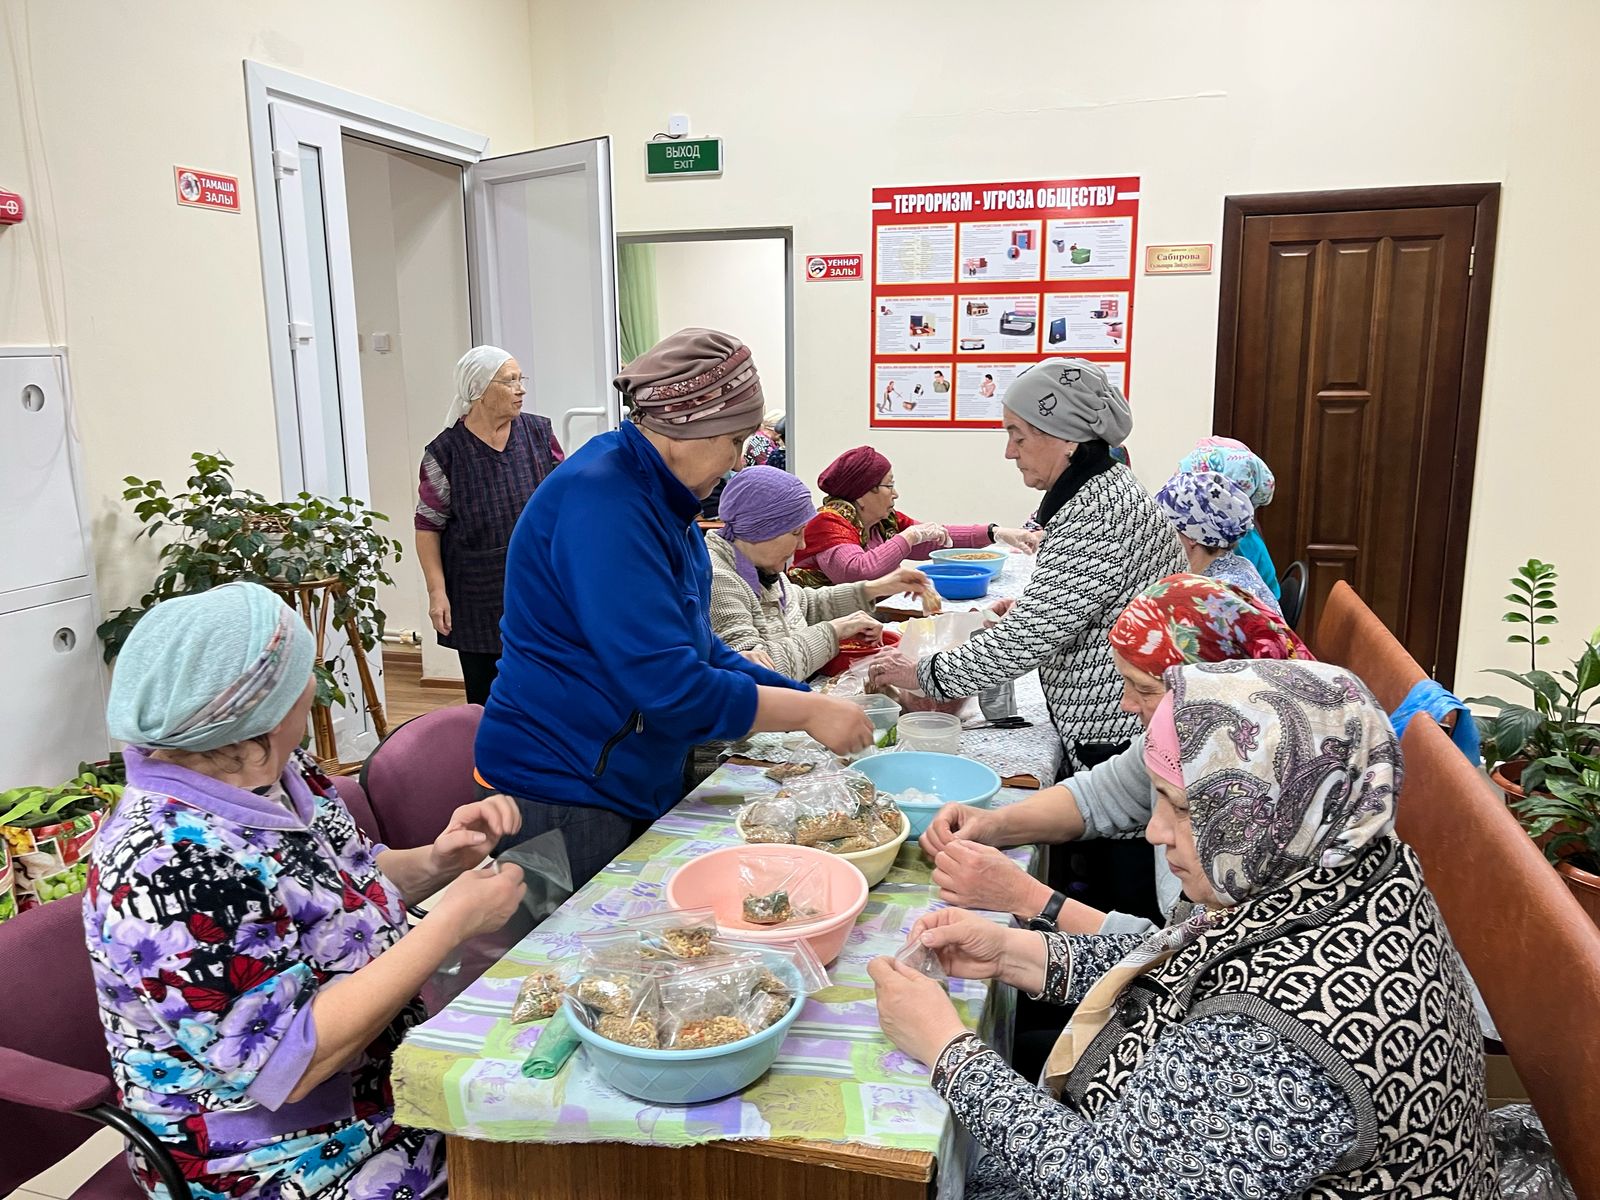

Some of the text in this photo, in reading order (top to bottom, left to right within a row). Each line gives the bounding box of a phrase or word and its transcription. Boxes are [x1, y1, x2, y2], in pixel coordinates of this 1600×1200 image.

[666, 145, 700, 159] ВЫХОД
[674, 160, 694, 169] EXIT
[200, 178, 235, 192] ТАМАША
[205, 191, 233, 205] ЗАЛЫ
[893, 191, 973, 214] ТЕРРОРИЗМ
[982, 188, 1034, 211] УГРОЗА
[1036, 185, 1116, 211] ОБЩЕСТВУ
[827, 258, 859, 267] УЕННАР
[1157, 253, 1200, 262] Сабирова
[830, 268, 856, 277] ЗАЛЫ
